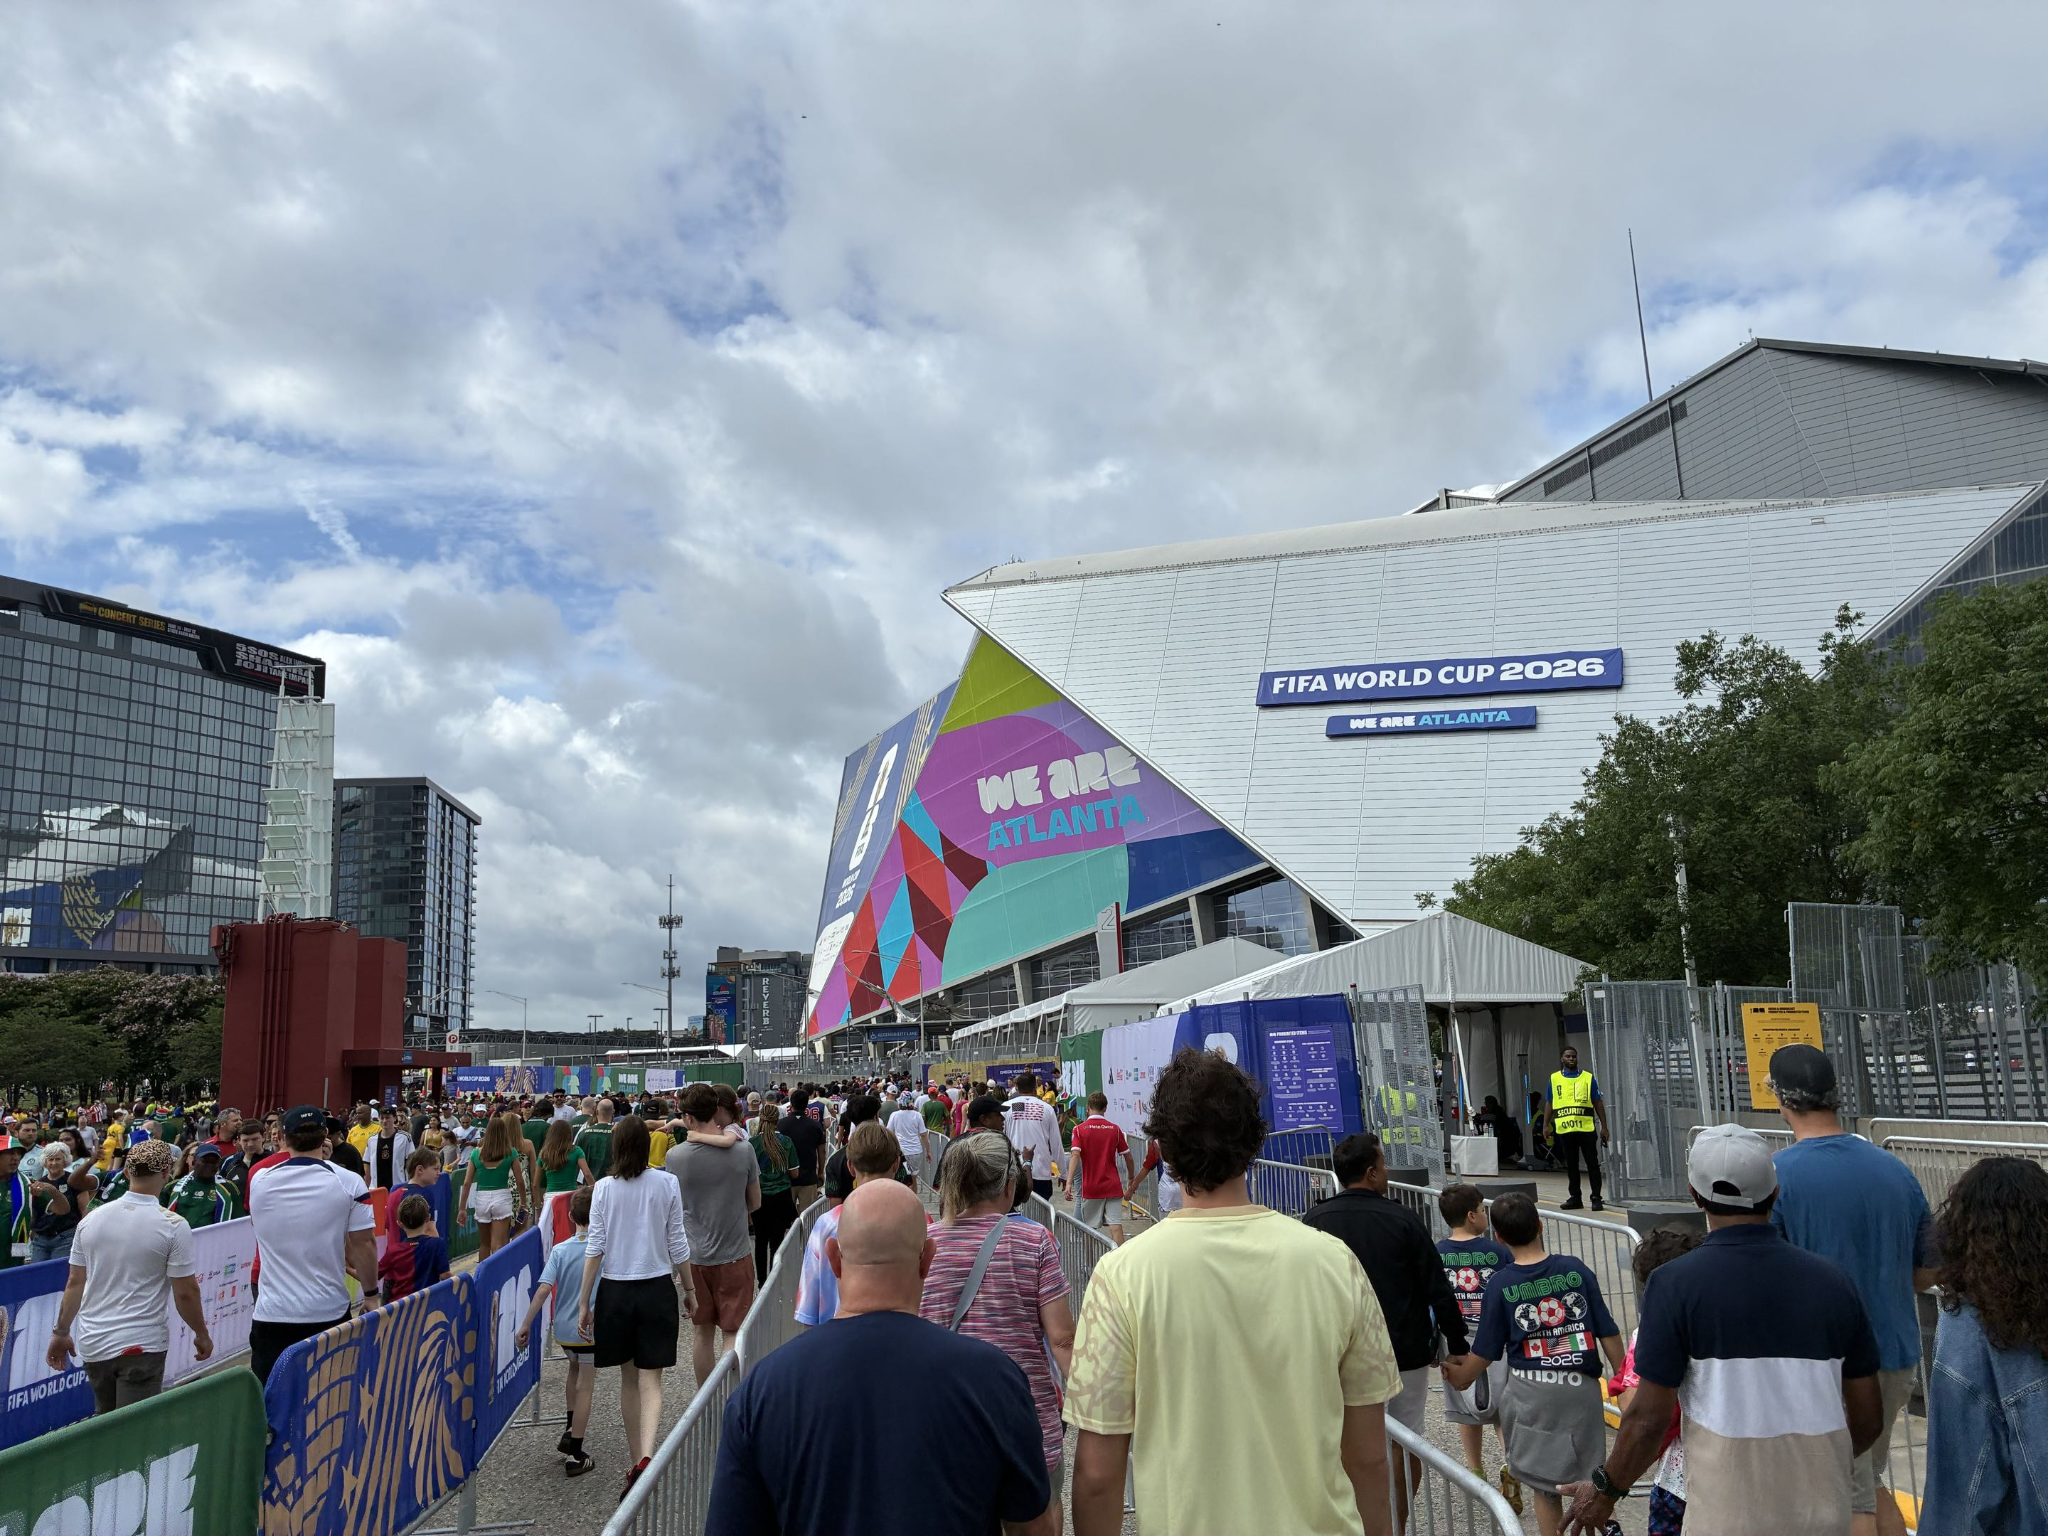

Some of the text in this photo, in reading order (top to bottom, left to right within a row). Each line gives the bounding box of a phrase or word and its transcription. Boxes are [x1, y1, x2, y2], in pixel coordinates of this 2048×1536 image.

[98, 607, 137, 624] CONCERT
[139, 616, 165, 631] SERIES
[235, 659, 269, 674] JOJI
[1272, 657, 1605, 695] FIFA WORLD CUP 2026
[1350, 710, 1511, 730] WE ARE ATLANTA
[977, 745, 1141, 814] WE ARE
[988, 793, 1147, 851] ATLANTA
[762, 977, 770, 1025] REVERB
[1557, 1107, 1585, 1117] SECURITY
[1502, 1271, 1583, 1302] UMBRO
[1552, 1322, 1585, 1336] AMERICA
[1540, 1353, 1584, 1366] 2026
[7, 1370, 86, 1412] FIFA WORLD CUP
